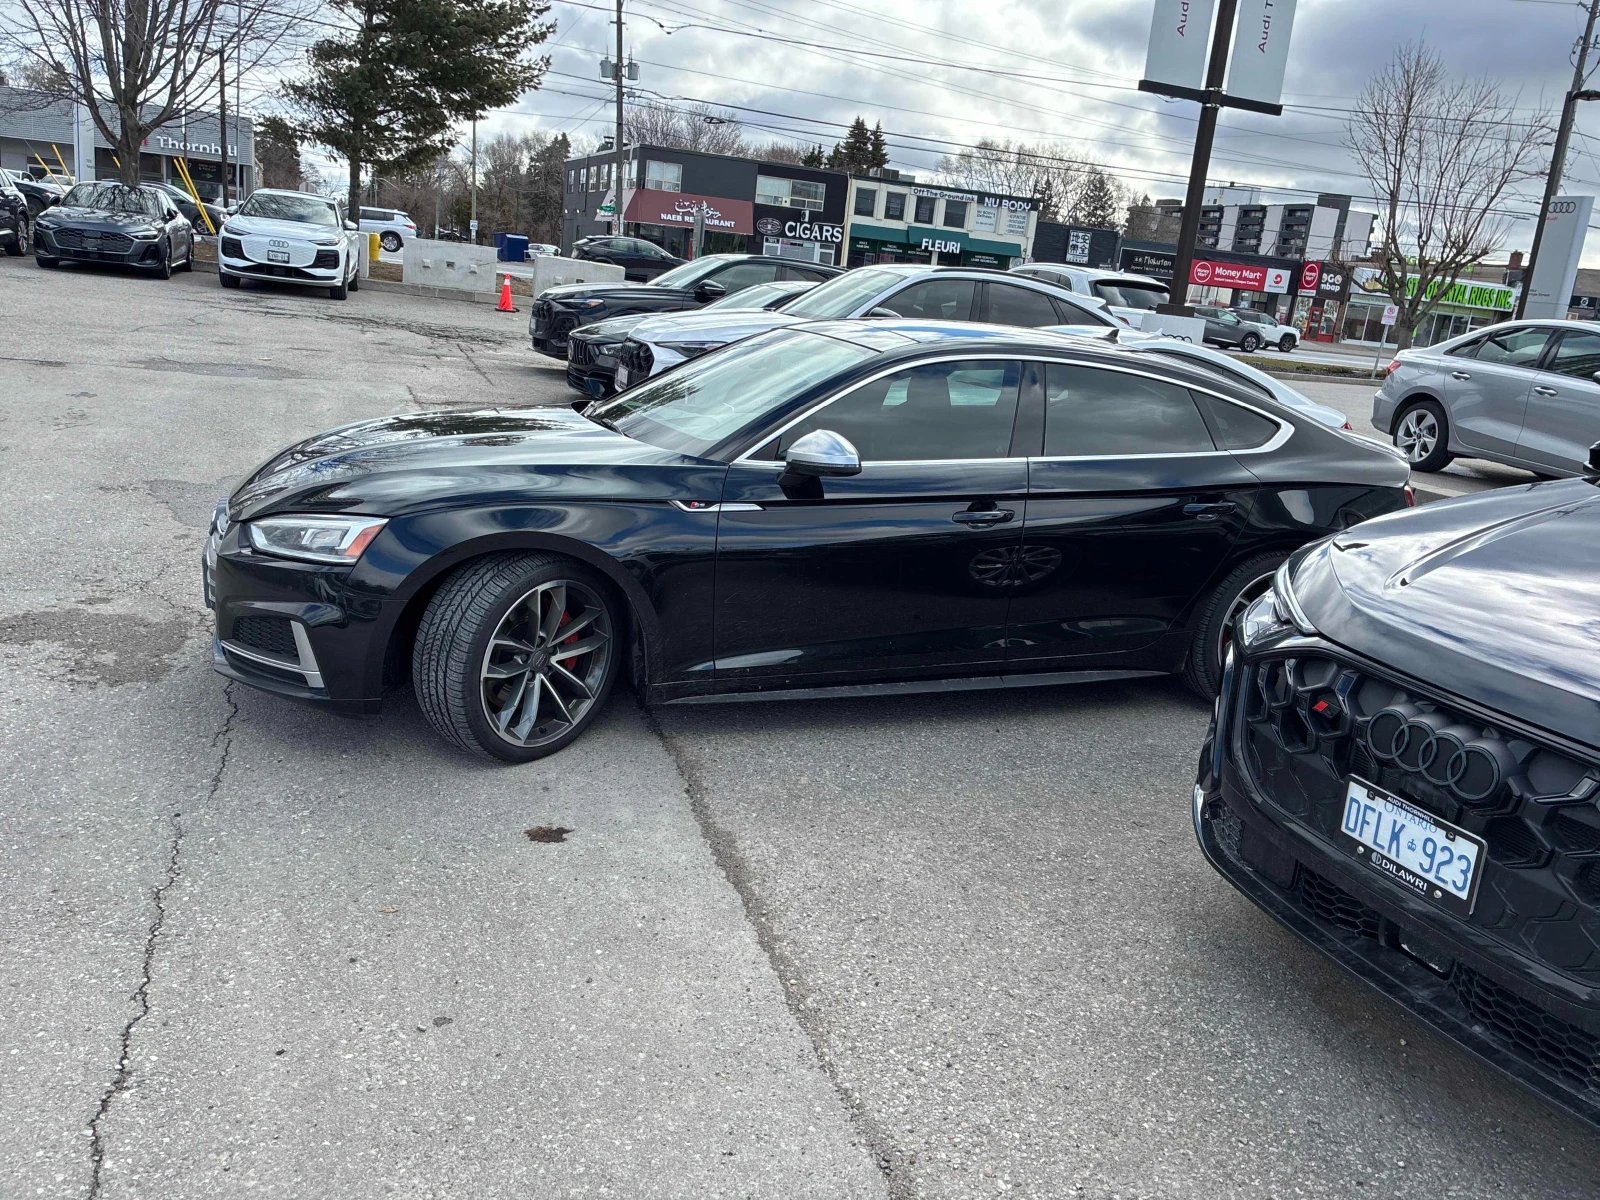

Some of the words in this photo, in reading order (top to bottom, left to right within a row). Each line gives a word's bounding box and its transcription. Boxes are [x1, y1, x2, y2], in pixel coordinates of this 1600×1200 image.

[1176, 0, 1190, 38] Aud
[1257, 14, 1272, 54] Audi
[156, 135, 237, 157] Thornhll
[926, 189, 938, 197] The
[939, 191, 964, 200] Ground
[984, 196, 1000, 207] NU
[1001, 199, 1031, 212] BODY
[660, 213, 682, 222] NAEB
[684, 215, 735, 228] REAURANT
[784, 221, 843, 242] CIGARS
[921, 238, 961, 254] FLEURI
[1215, 267, 1241, 279] Money
[1242, 269, 1261, 280] Mart
[1468, 286, 1496, 307] RUGS
[1386, 796, 1402, 808] AUDI
[1402, 803, 1435, 823] THORNHILL
[1344, 796, 1406, 859] DFLK
[1418, 837, 1472, 892] 923
[1381, 859, 1428, 891] DILAWRI
